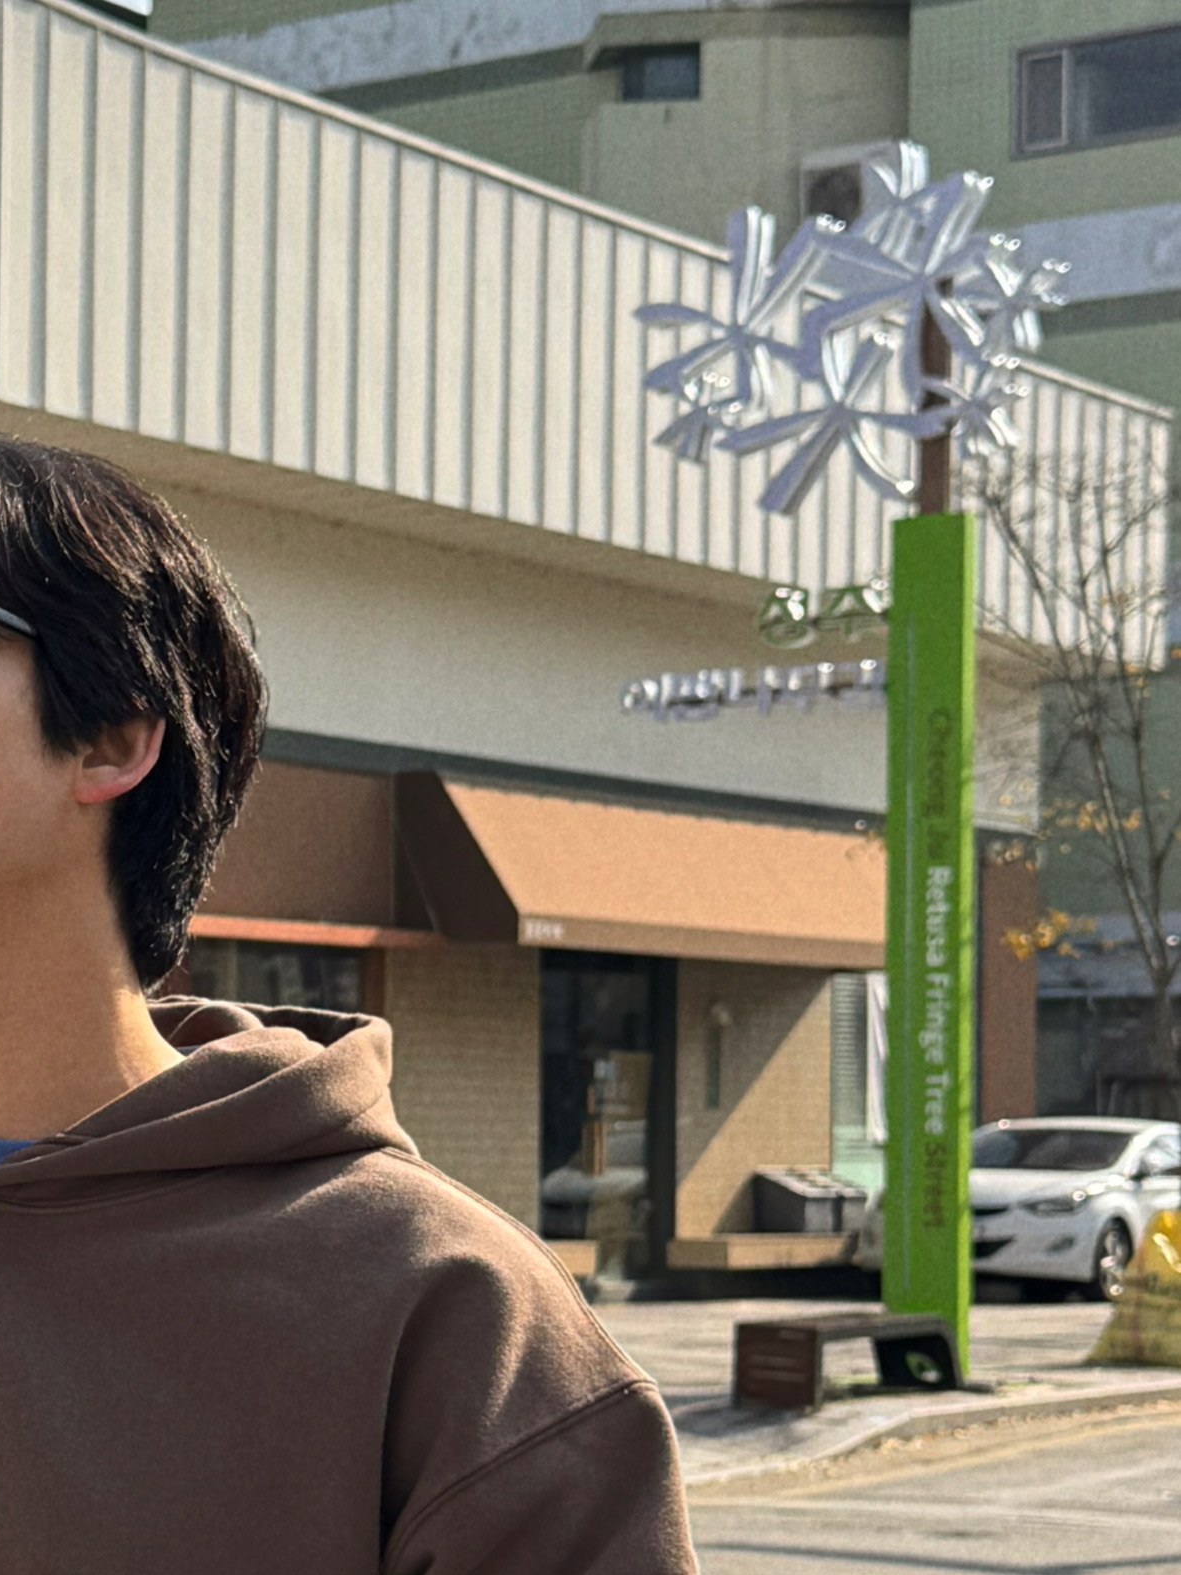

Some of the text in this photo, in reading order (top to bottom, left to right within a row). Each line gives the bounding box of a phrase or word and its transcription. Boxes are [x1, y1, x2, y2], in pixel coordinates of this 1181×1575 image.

[926, 866, 952, 967] Retusa
[919, 973, 951, 1066] Fringe
[925, 1071, 950, 1136] Tree
[924, 1142, 945, 1226] Street
